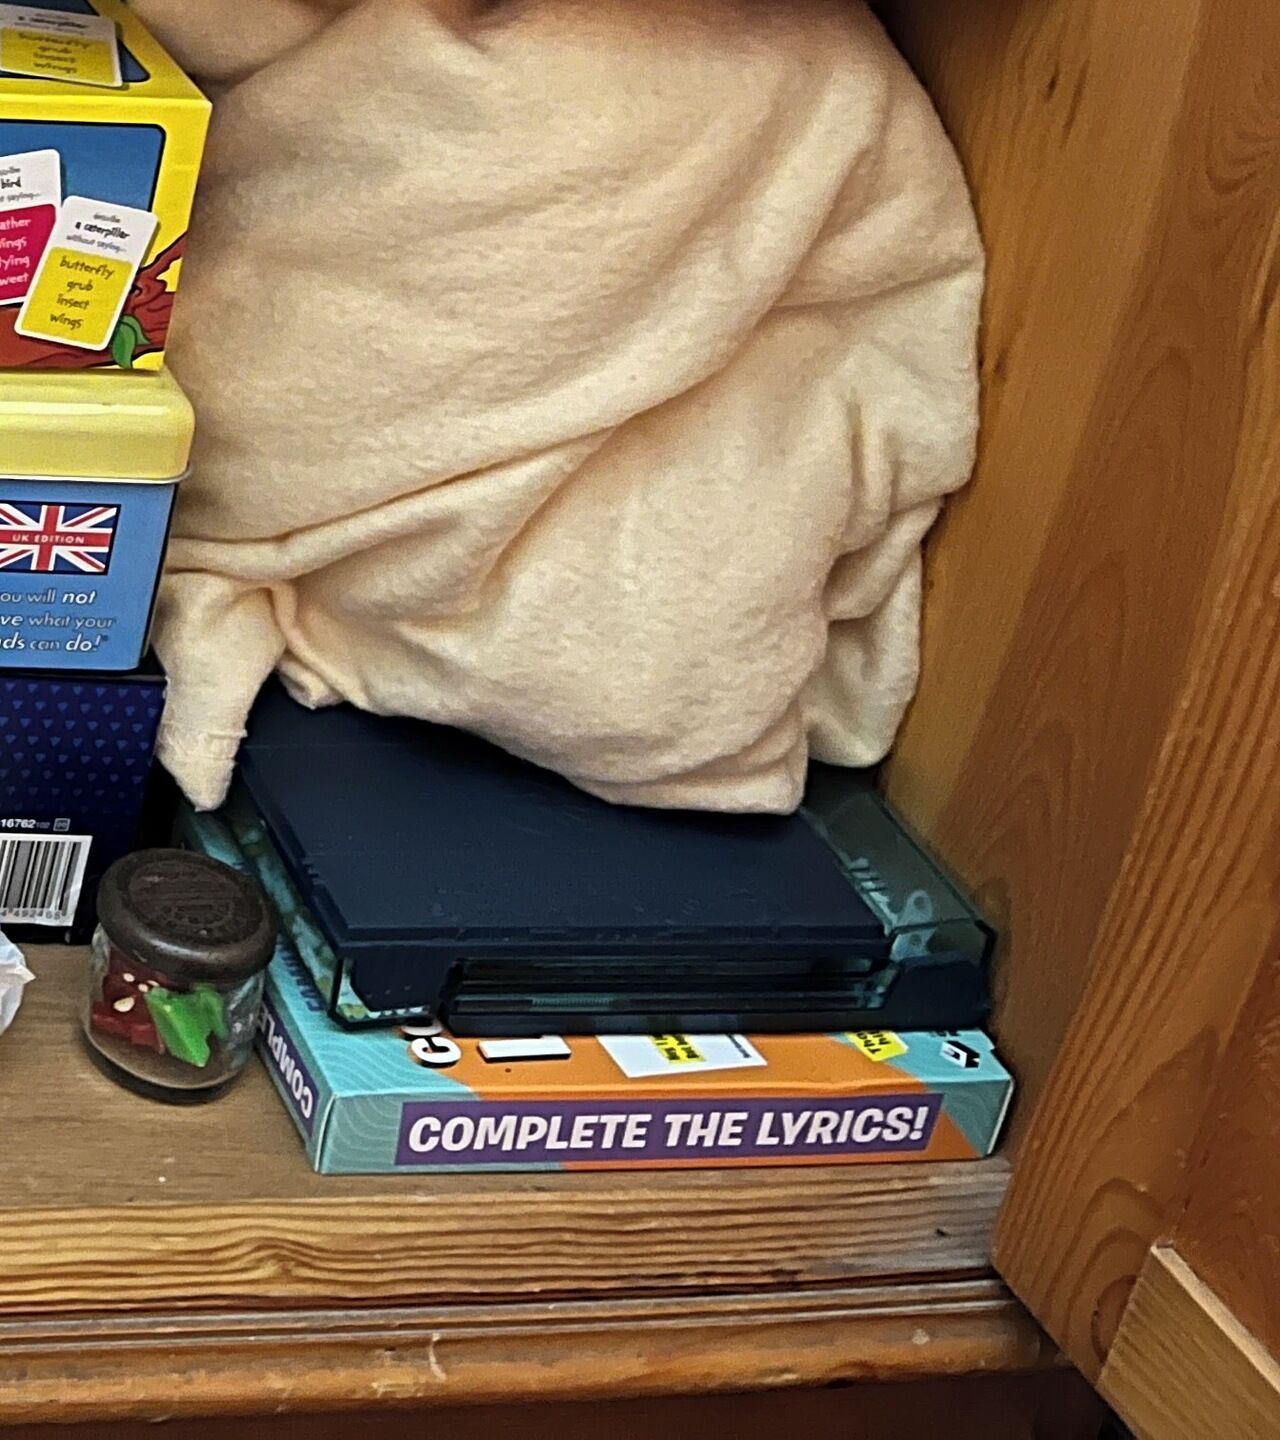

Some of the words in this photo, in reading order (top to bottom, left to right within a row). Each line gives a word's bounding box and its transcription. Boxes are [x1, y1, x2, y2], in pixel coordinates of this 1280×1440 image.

[59, 256, 115, 280] butterfly
[66, 280, 94, 292] grub
[56, 293, 90, 310] insect
[50, 312, 83, 330] wings
[12, 533, 29, 543] UK
[34, 535, 85, 545] EDITION
[28, 589, 56, 604] will
[63, 589, 96, 604] not
[409, 1115, 653, 1152] COMPLETE
[664, 1111, 755, 1148] THE
[757, 1105, 929, 1146] LYRICS!
